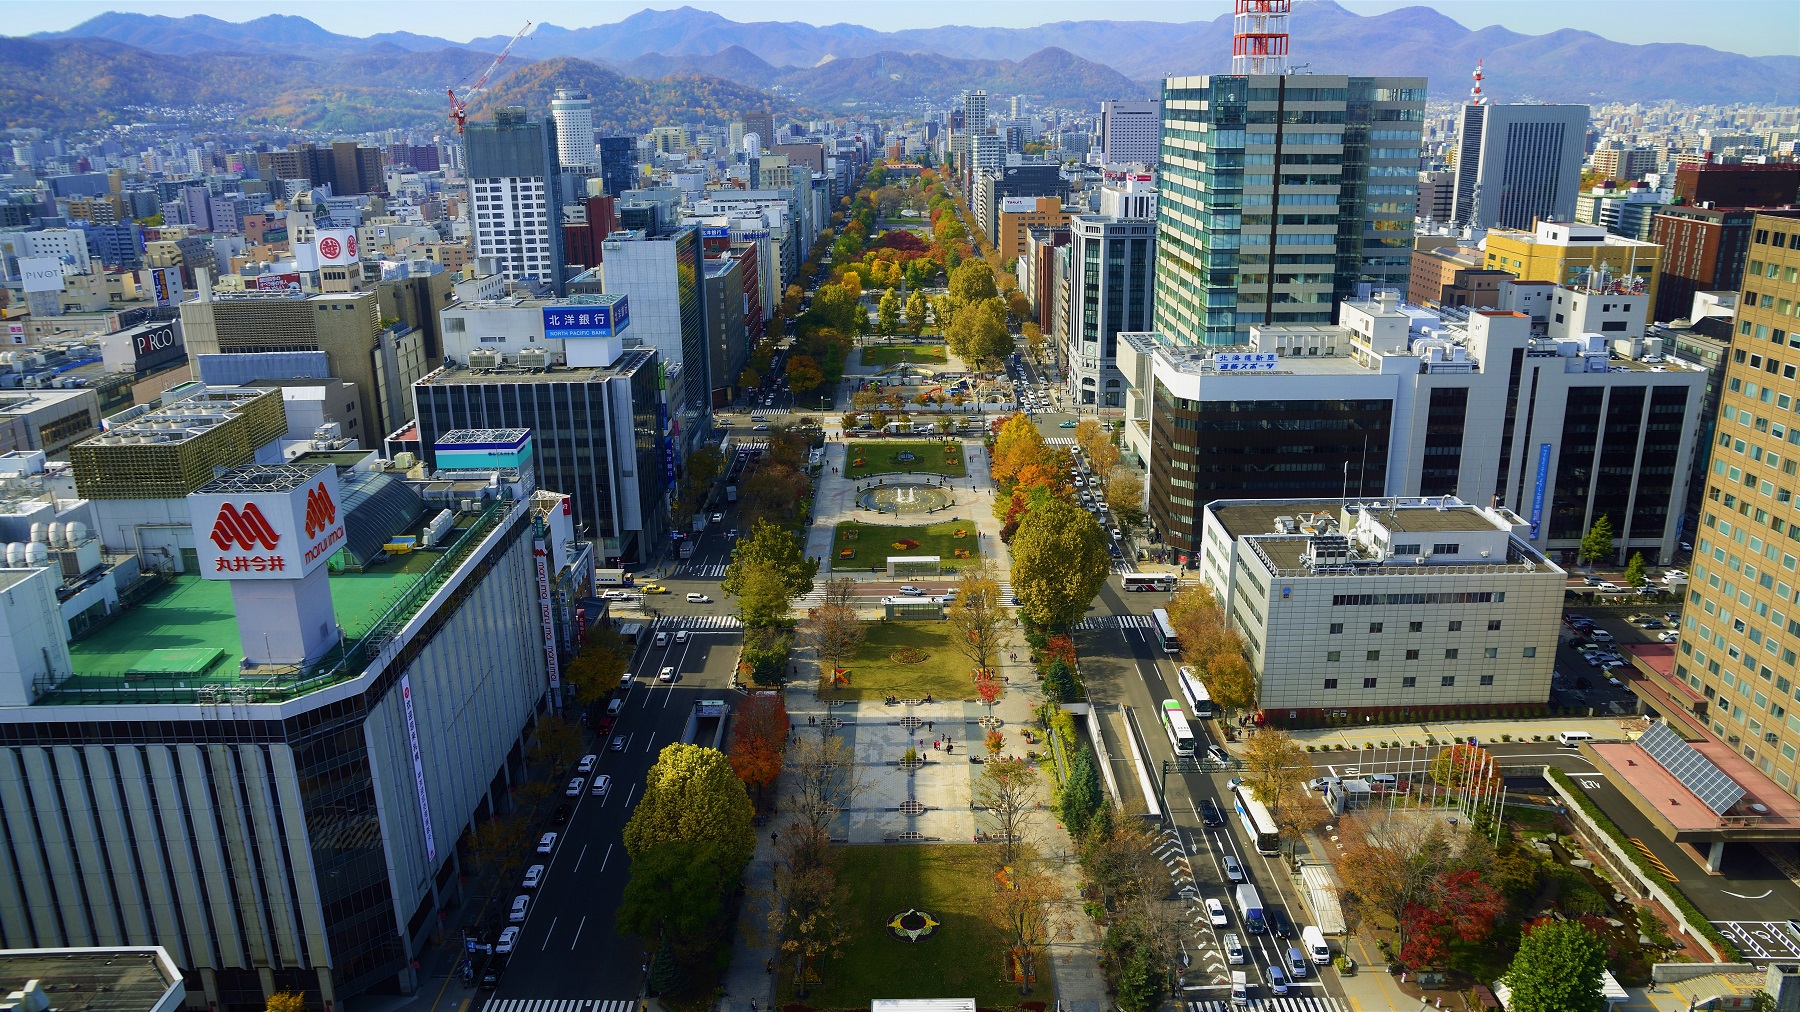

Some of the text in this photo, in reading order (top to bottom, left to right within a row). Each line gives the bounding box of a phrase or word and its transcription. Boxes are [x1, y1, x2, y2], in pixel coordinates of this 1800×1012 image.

[26, 270, 58, 279] PIVOT
[549, 314, 605, 326] 北洋銀行
[137, 329, 172, 354] PARCO
[215, 556, 285, 571] 丸井今井
